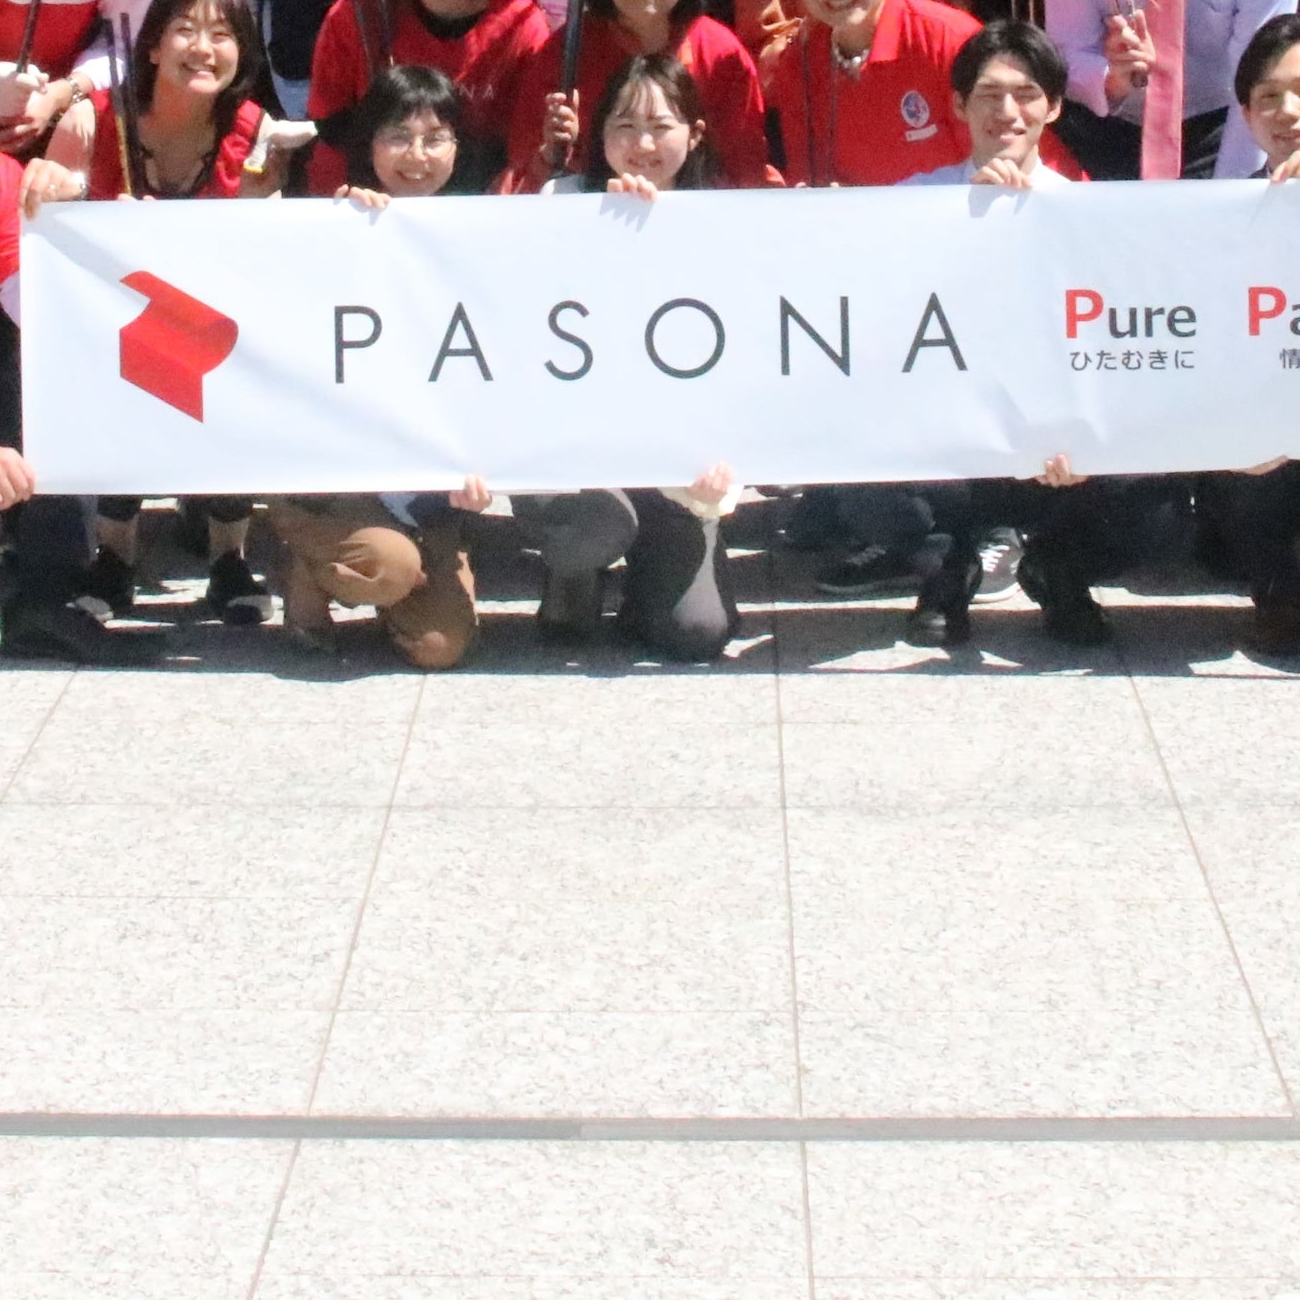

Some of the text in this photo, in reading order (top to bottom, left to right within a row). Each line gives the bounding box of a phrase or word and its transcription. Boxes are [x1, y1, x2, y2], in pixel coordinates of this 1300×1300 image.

[333, 292, 968, 384] PASONA
[1064, 288, 1198, 340] Pure
[1069, 348, 1196, 372] ひたむきに
